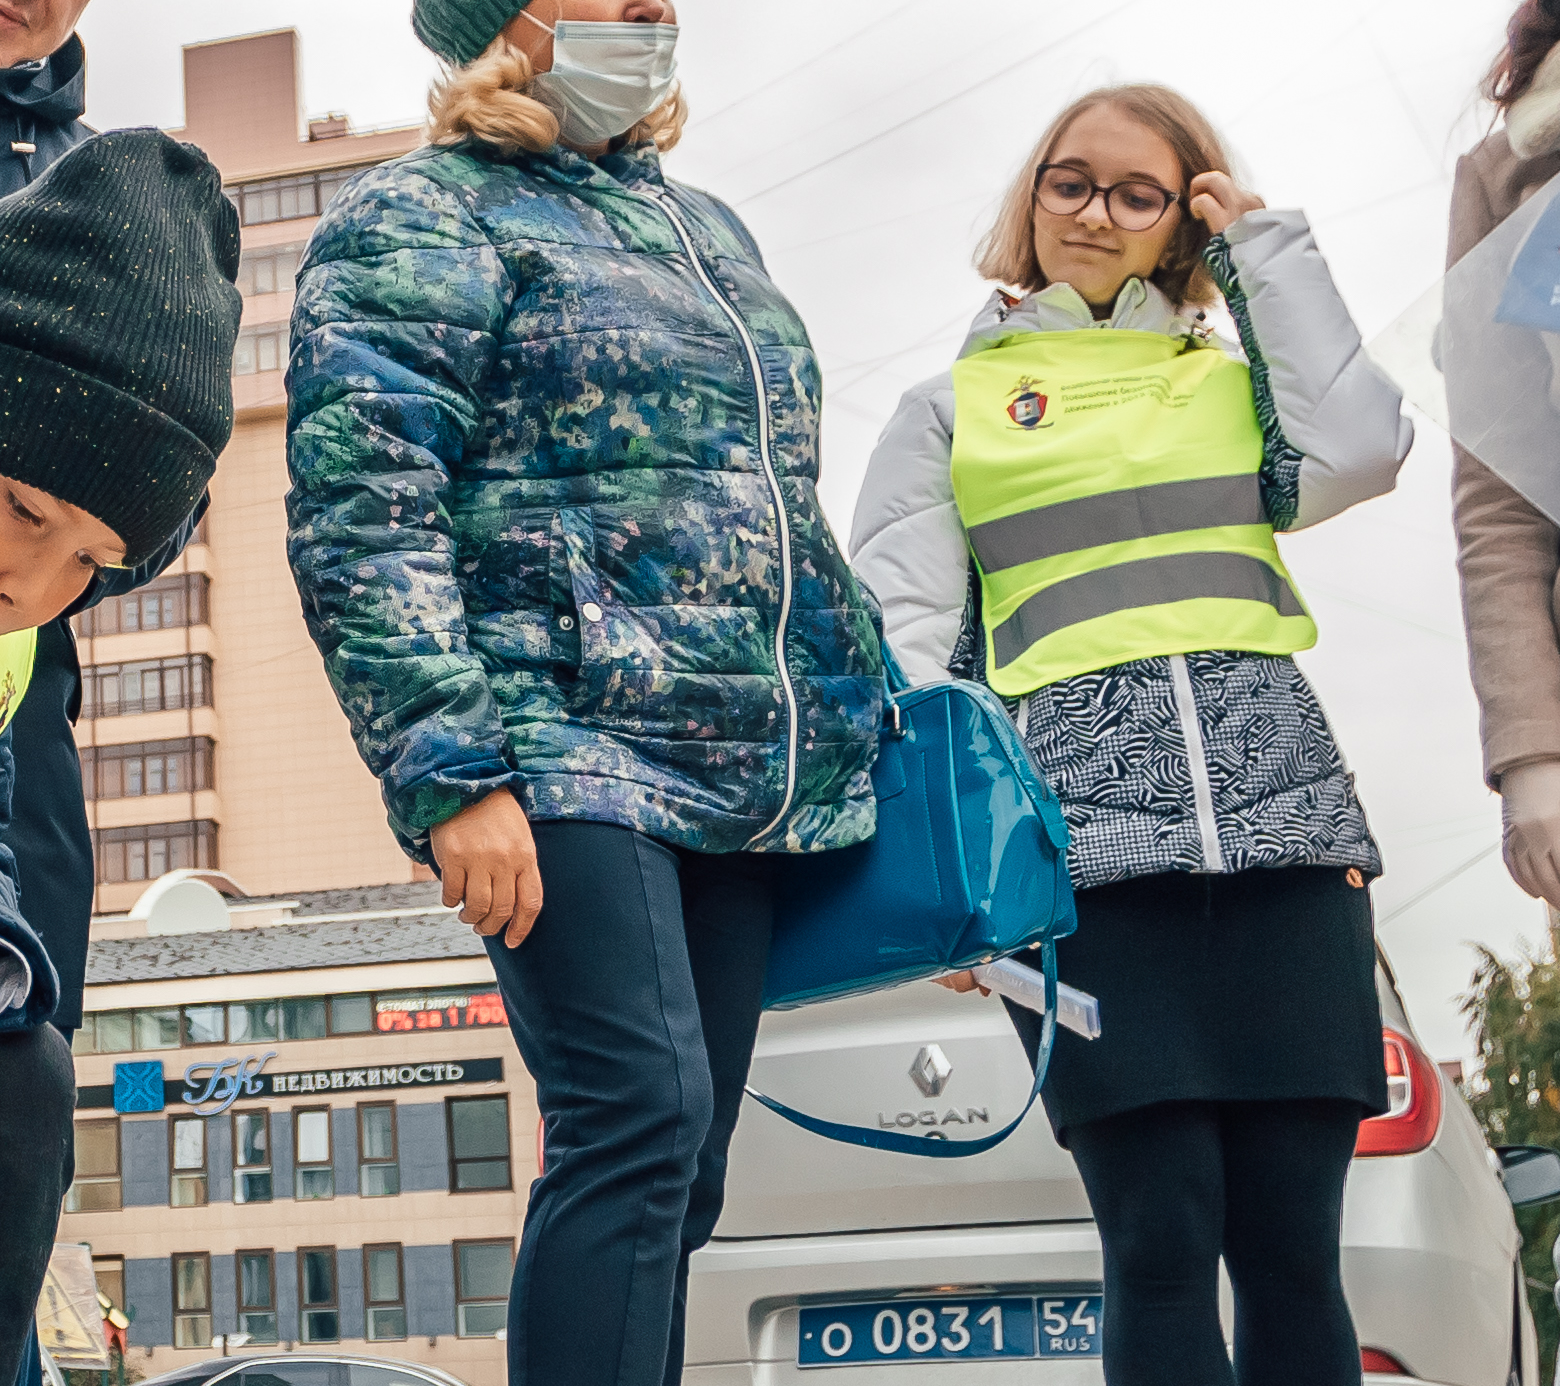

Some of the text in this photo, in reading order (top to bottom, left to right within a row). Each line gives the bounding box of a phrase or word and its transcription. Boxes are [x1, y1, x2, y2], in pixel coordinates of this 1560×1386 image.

[272, 1063, 465, 1093] НЕДВИЖИМОСТЬ
[878, 1106, 991, 1129] LOGAN
[871, 1305, 1005, 1355] 0831
[1042, 1299, 1096, 1336] 54
[1050, 1336, 1091, 1352] RUS
